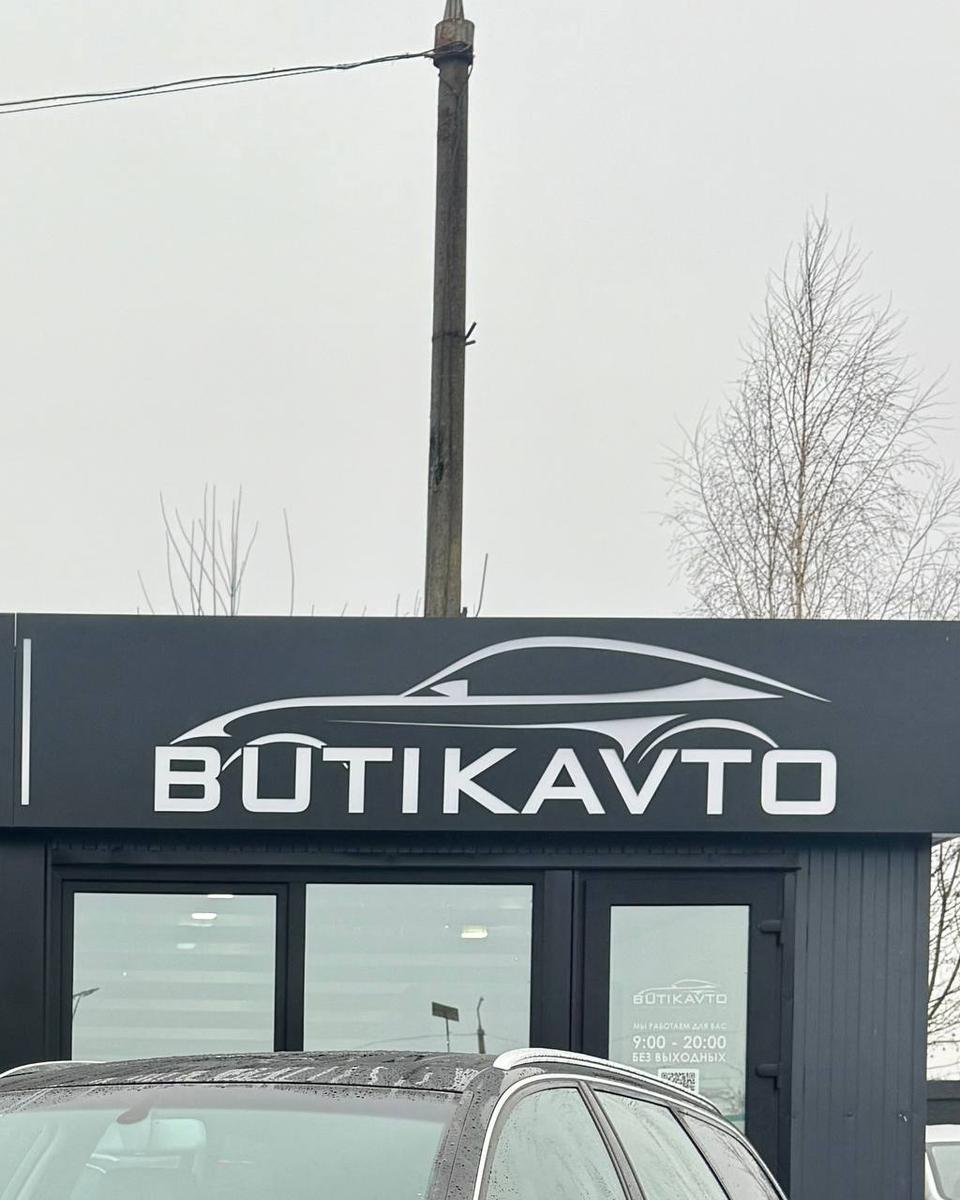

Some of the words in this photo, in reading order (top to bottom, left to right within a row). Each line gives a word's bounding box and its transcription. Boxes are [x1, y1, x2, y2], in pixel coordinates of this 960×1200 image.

[154, 745, 837, 816] BUTIKAVTO
[633, 993, 727, 1004] BUTIKAVTO
[632, 1035, 666, 1049] 9:00
[683, 1035, 727, 1049] 20:00
[632, 1052, 651, 1062] БЕЗ
[655, 1052, 727, 1063] ВЫХОДНЫХ
